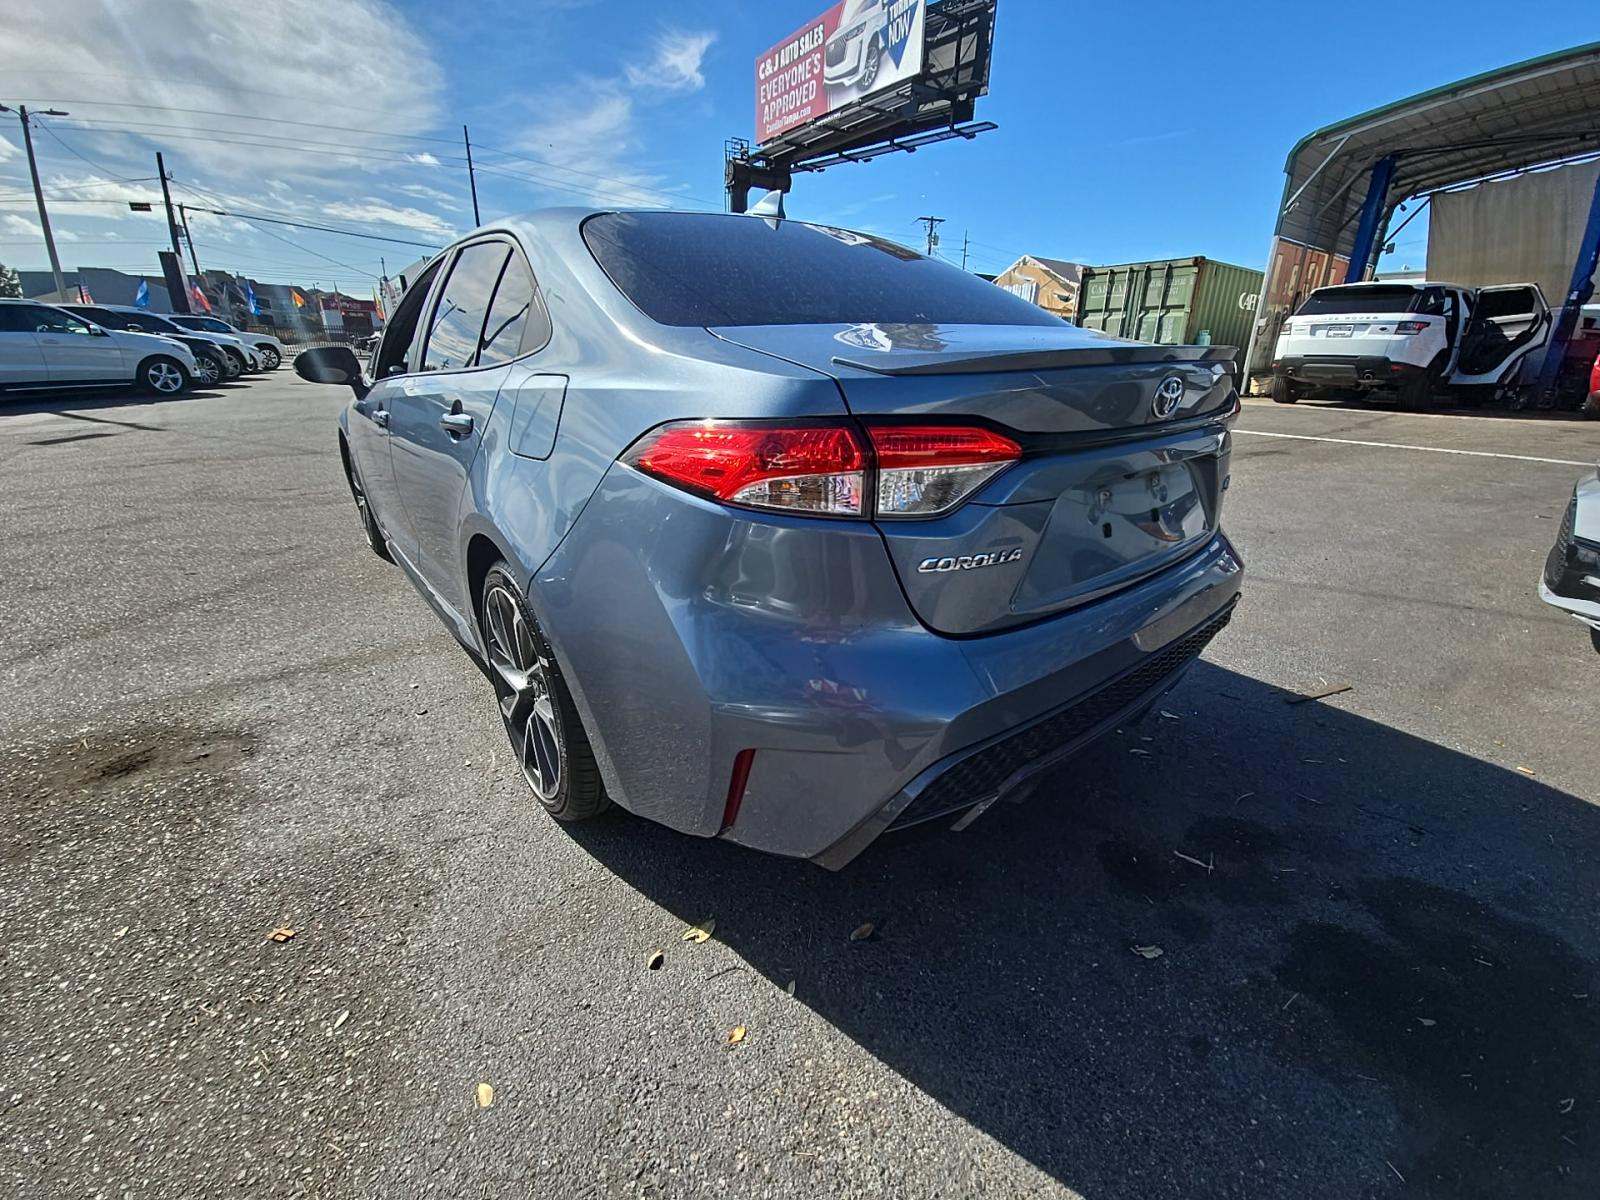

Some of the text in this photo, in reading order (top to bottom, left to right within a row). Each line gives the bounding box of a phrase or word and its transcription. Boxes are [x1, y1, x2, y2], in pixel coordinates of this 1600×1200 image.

[780, 40, 799, 68] AUTO
[799, 24, 824, 56] SALES
[888, 9, 911, 49] NOW
[760, 52, 821, 104] EVERYONE'S
[763, 79, 817, 124] APPROVED
[917, 548, 1023, 574] COROLLA
